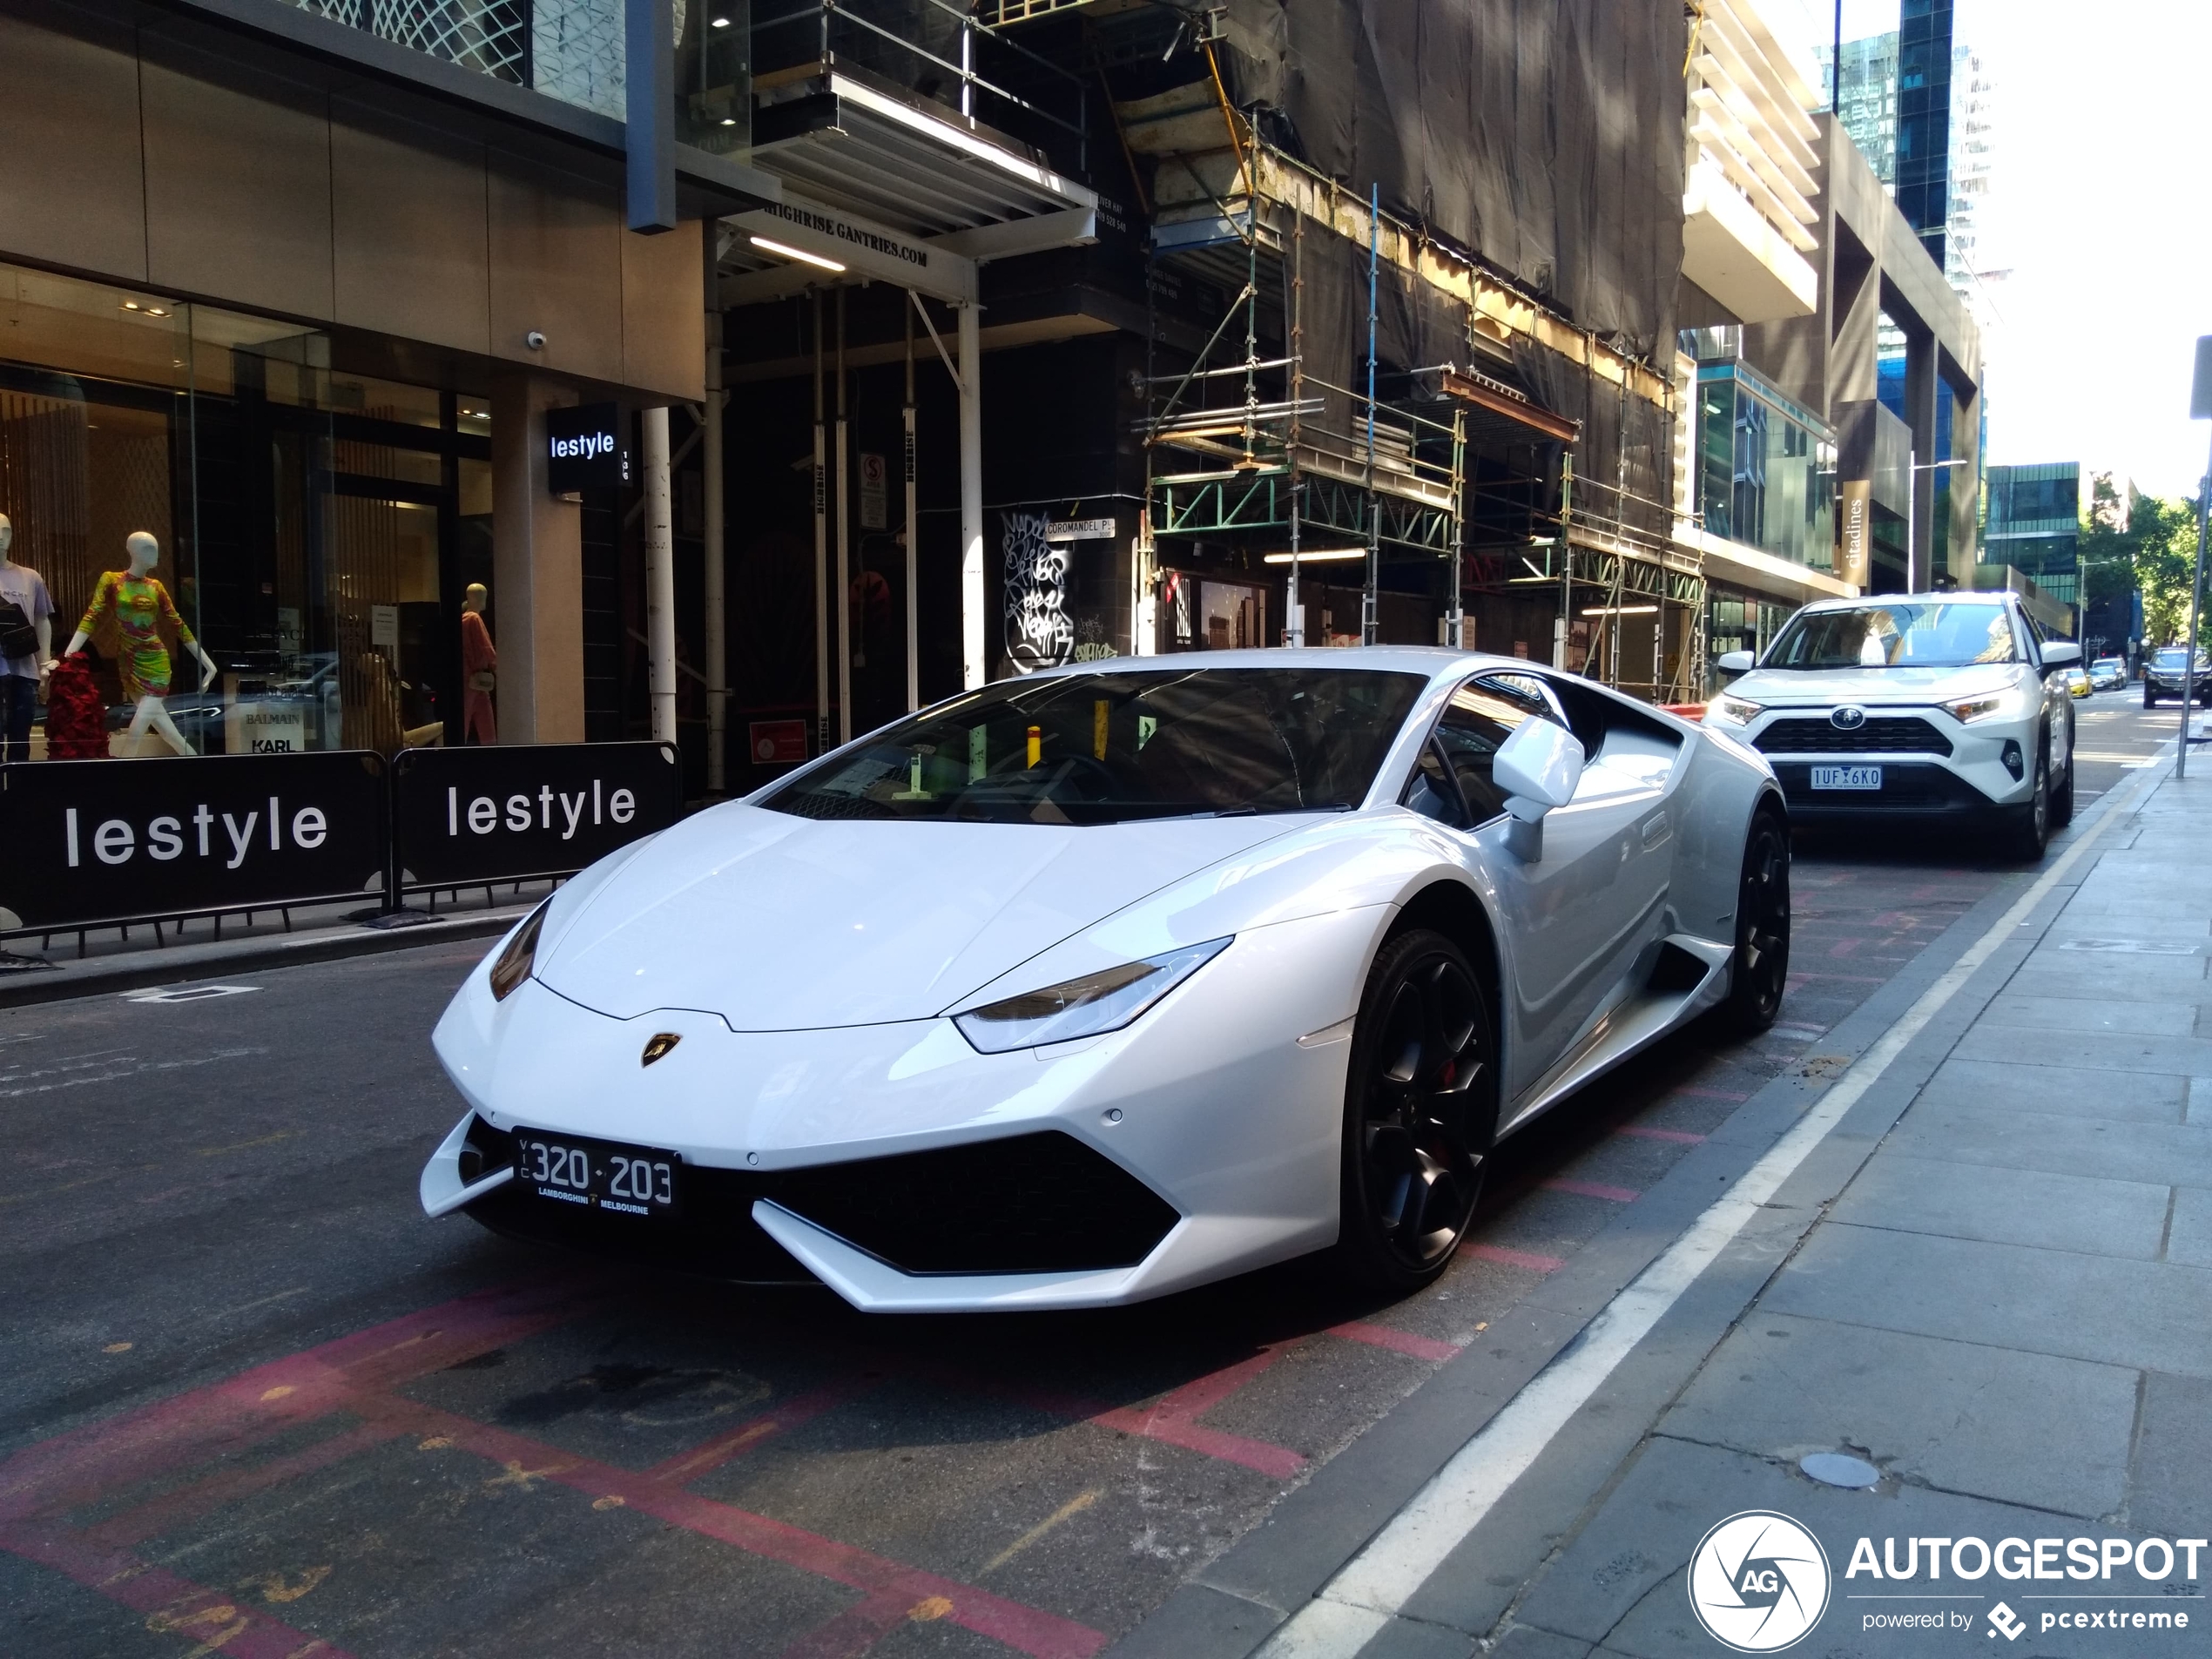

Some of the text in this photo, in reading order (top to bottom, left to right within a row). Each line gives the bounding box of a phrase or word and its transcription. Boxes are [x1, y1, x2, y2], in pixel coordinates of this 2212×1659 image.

[836, 223, 927, 267] GANTRIES.COM
[551, 431, 614, 460] lestyle
[1048, 521, 1098, 534] COROMANDEL
[1845, 499, 1862, 569] citadines
[246, 713, 300, 725] BALMAIN
[252, 739, 295, 754] KARL
[1816, 771, 1839, 784] 1UF
[448, 779, 635, 840] lestyle
[66, 796, 327, 869] lestyle
[530, 1142, 671, 1204] 320 203
[538, 1186, 649, 1215] LAMBORGHINI MELBOURNE
